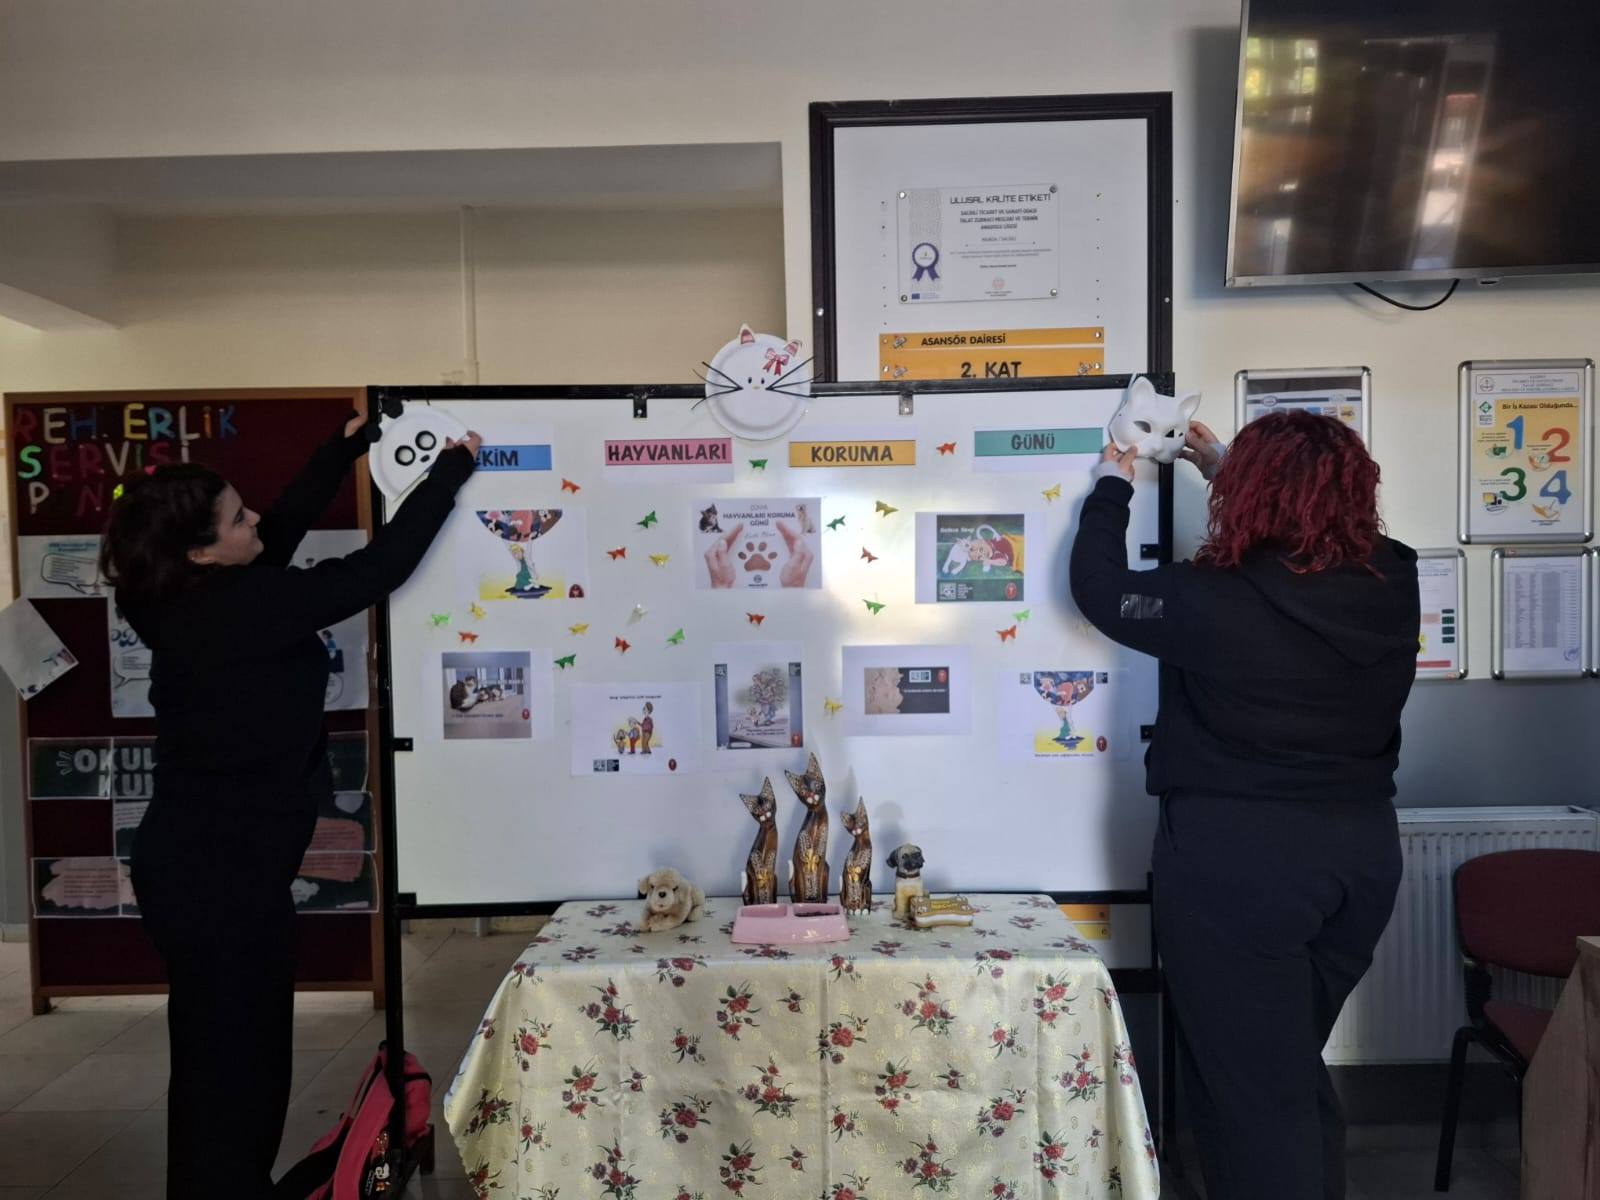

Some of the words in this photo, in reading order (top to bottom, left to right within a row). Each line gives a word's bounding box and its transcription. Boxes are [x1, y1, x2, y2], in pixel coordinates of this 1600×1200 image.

[950, 196, 984, 204] ULUSAL
[921, 335, 967, 346] ASANSÖR
[969, 333, 1006, 344] DAİRESİ
[961, 361, 977, 378] 2.
[985, 361, 1022, 378] KAT
[608, 443, 727, 462] HAYVANLARI
[811, 444, 894, 464] KORUMA
[1010, 432, 1056, 451] GÜNÜ
[1506, 415, 1524, 450] 1
[1542, 427, 1571, 462] 2
[1500, 467, 1527, 501] 3
[1540, 470, 1572, 504] 4
[74, 747, 158, 773] OKUL
